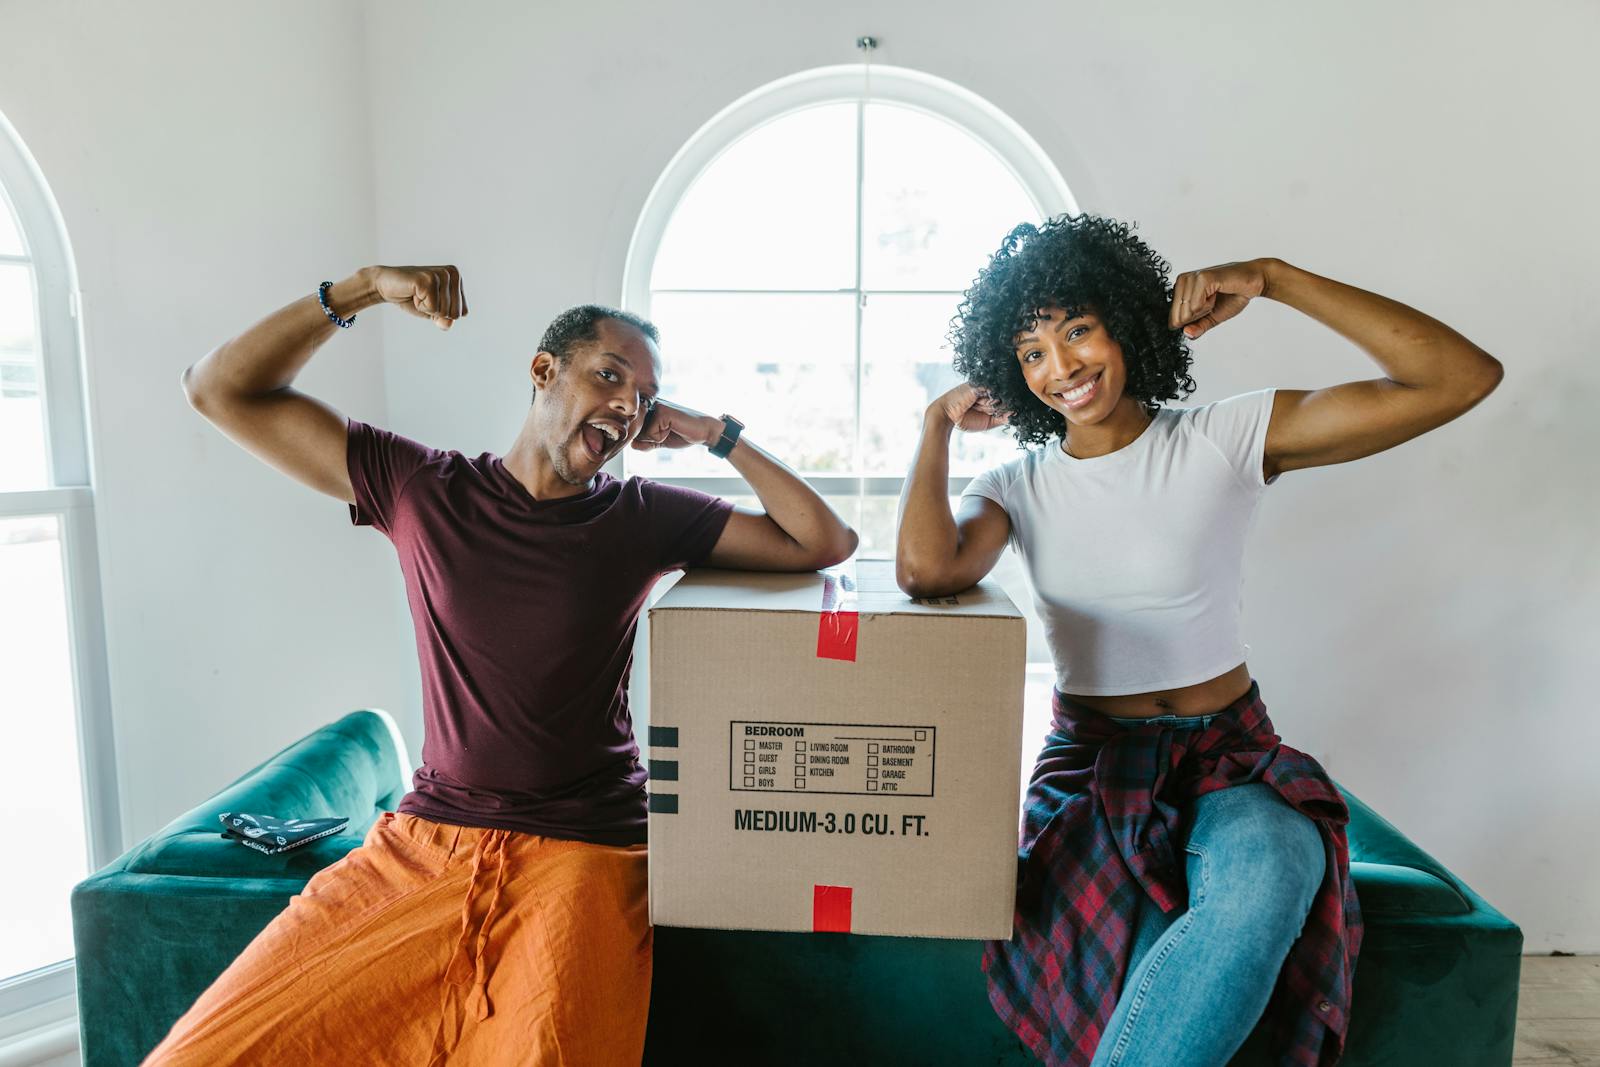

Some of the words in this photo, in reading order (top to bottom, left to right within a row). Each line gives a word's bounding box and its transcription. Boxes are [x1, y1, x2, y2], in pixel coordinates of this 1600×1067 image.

[745, 726, 804, 737] BEDROOM
[759, 742, 783, 751] MASTER
[810, 744, 829, 753] LIVING
[831, 744, 848, 753] ROOM
[882, 745, 915, 755] BATHROOM
[759, 754, 778, 763] GUEST
[810, 756, 830, 765] DINING
[832, 756, 849, 766] ROOM
[882, 758, 913, 767] BASEMENT
[759, 767, 776, 776] GIRLS
[810, 768, 834, 778] KITCHEN
[882, 770, 906, 780] GARAGE
[758, 779, 774, 788] BOYS
[882, 783, 898, 792] ATTIC
[862, 814, 894, 835] CU.
[902, 815, 929, 836] FT.
